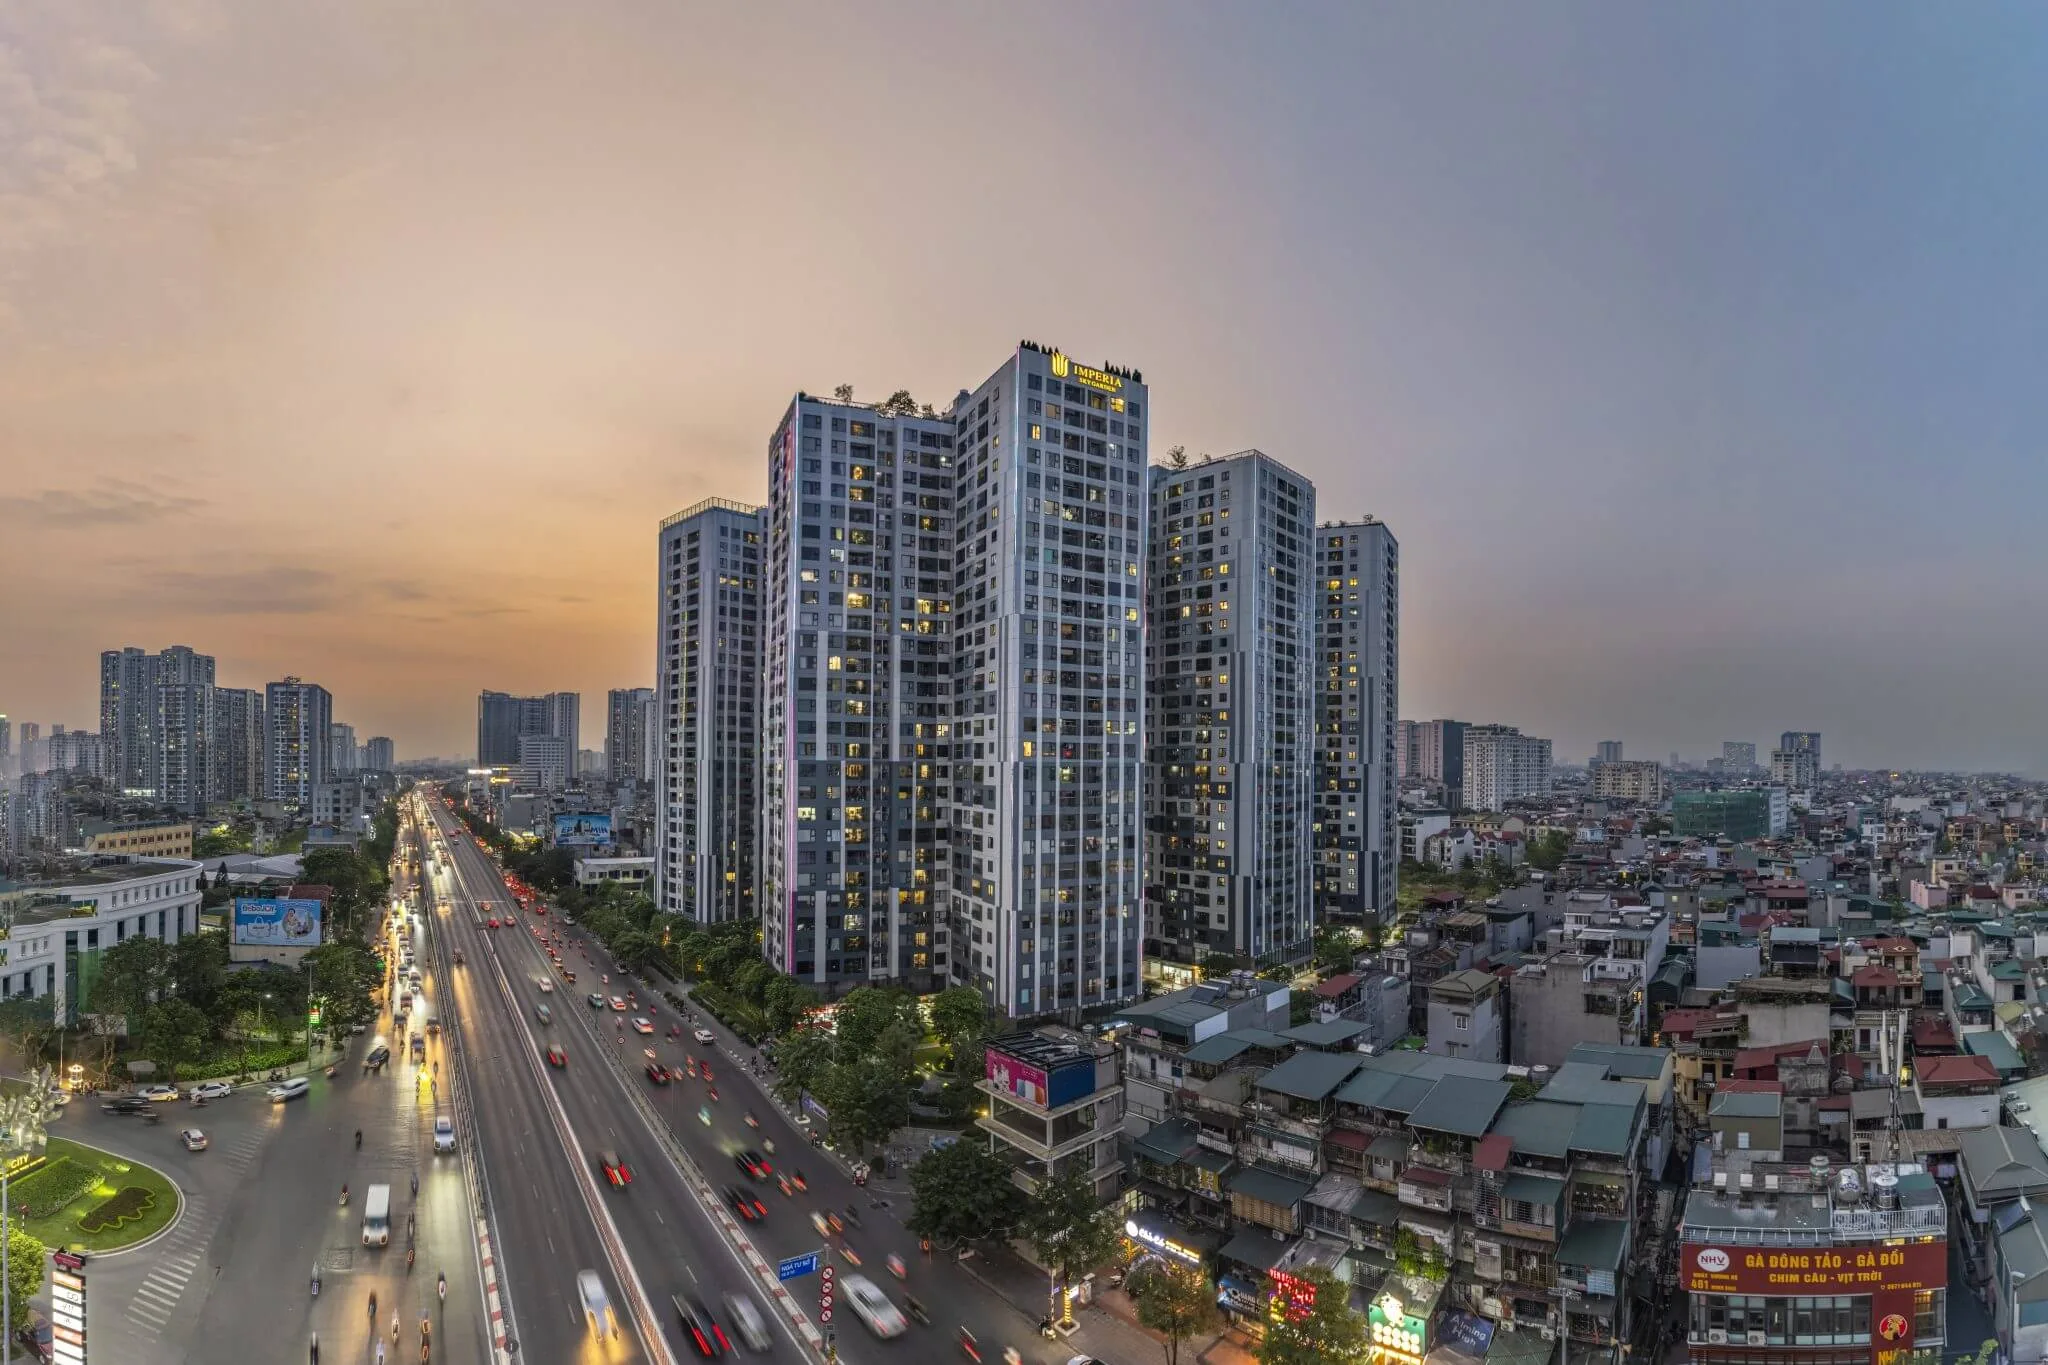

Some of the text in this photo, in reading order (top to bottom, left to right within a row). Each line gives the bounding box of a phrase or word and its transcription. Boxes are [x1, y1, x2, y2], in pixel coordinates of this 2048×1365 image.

[1074, 365, 1122, 388] IMPERIA
[10, 1153, 29, 1169] CITY
[1700, 1255, 1725, 1265] NHV
[1745, 1252, 1765, 1268] GÀ
[1769, 1253, 1810, 1269] ĐÔNG
[1814, 1251, 1842, 1269] TẢO
[1856, 1251, 1876, 1267] GÀ
[1769, 1273, 1800, 1283] CHIM
[1804, 1272, 1827, 1283] CÂU
[1837, 1273, 1855, 1284] VỊT
[1450, 1314, 1486, 1341] Aiming
[1452, 1325, 1477, 1346] High
